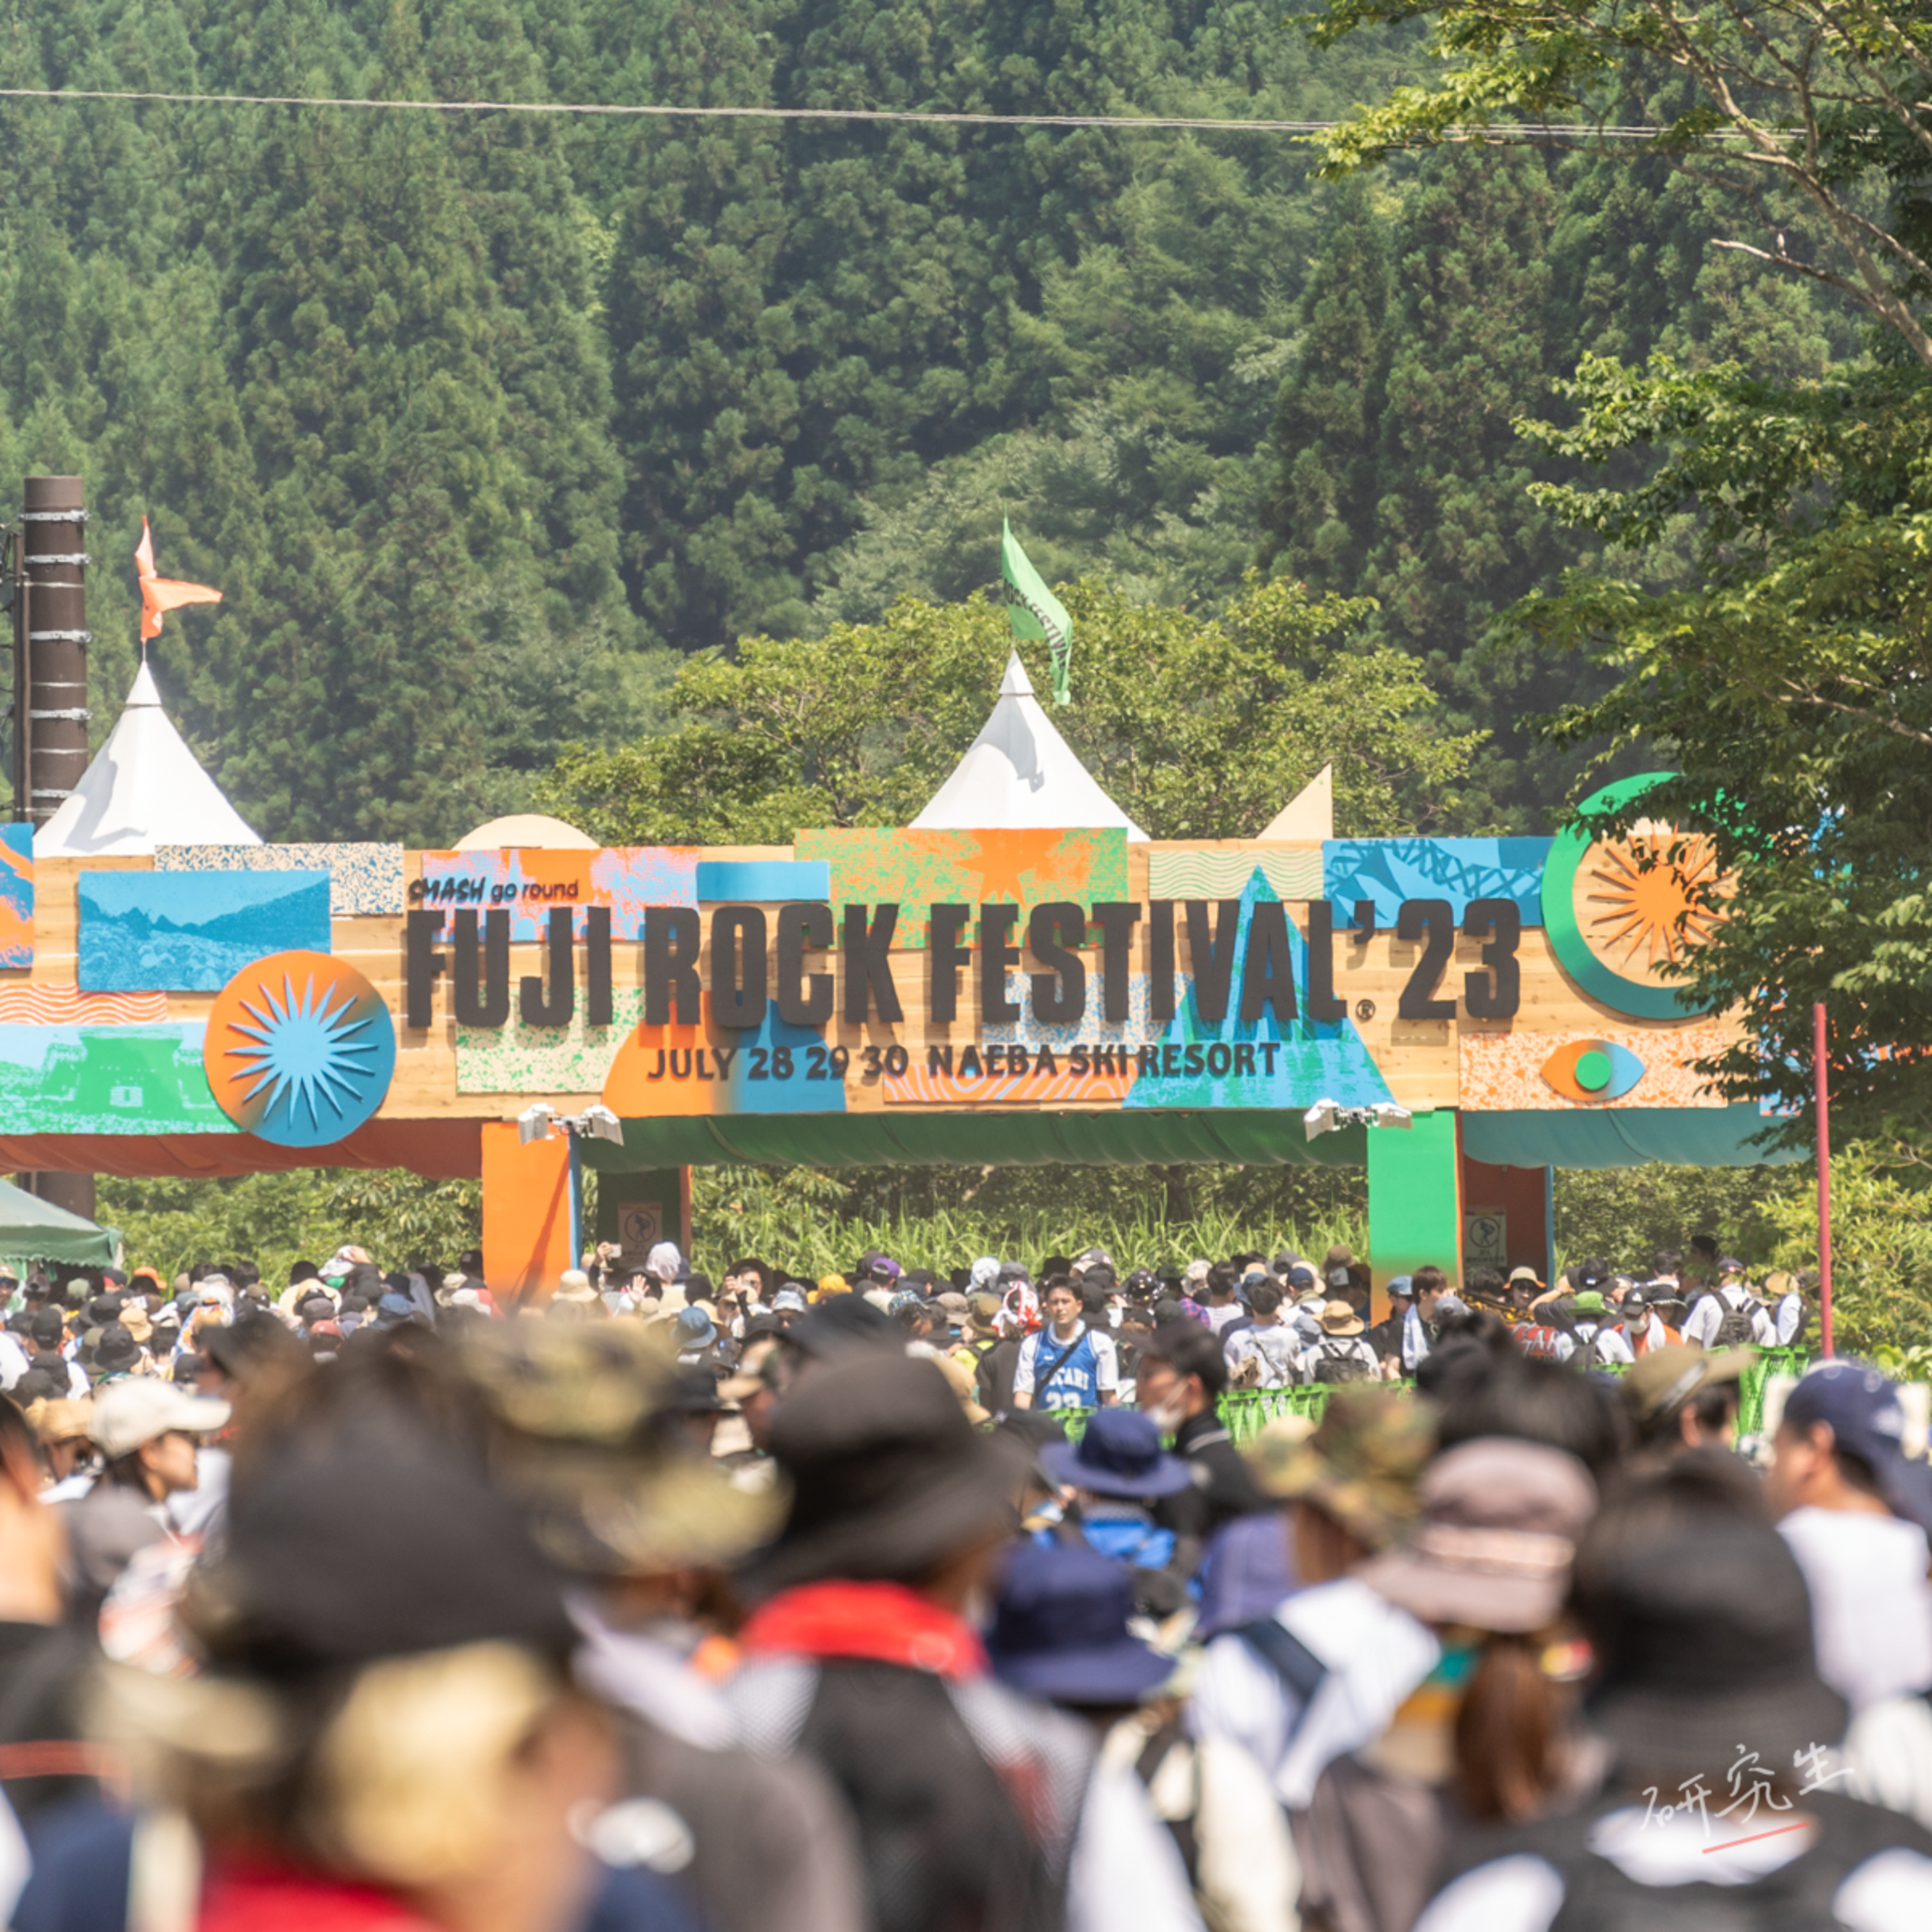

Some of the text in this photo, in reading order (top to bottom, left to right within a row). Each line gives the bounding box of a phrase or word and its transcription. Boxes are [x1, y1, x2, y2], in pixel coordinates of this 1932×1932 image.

[408, 876, 579, 904] SMASH go round
[407, 906, 612, 1027] FUJI
[644, 903, 904, 1027] ROCK
[930, 899, 1347, 1023] FESTIVAL
[647, 1043, 1281, 1080] JULY 28 29 30 NAEBA SKI RESORT
